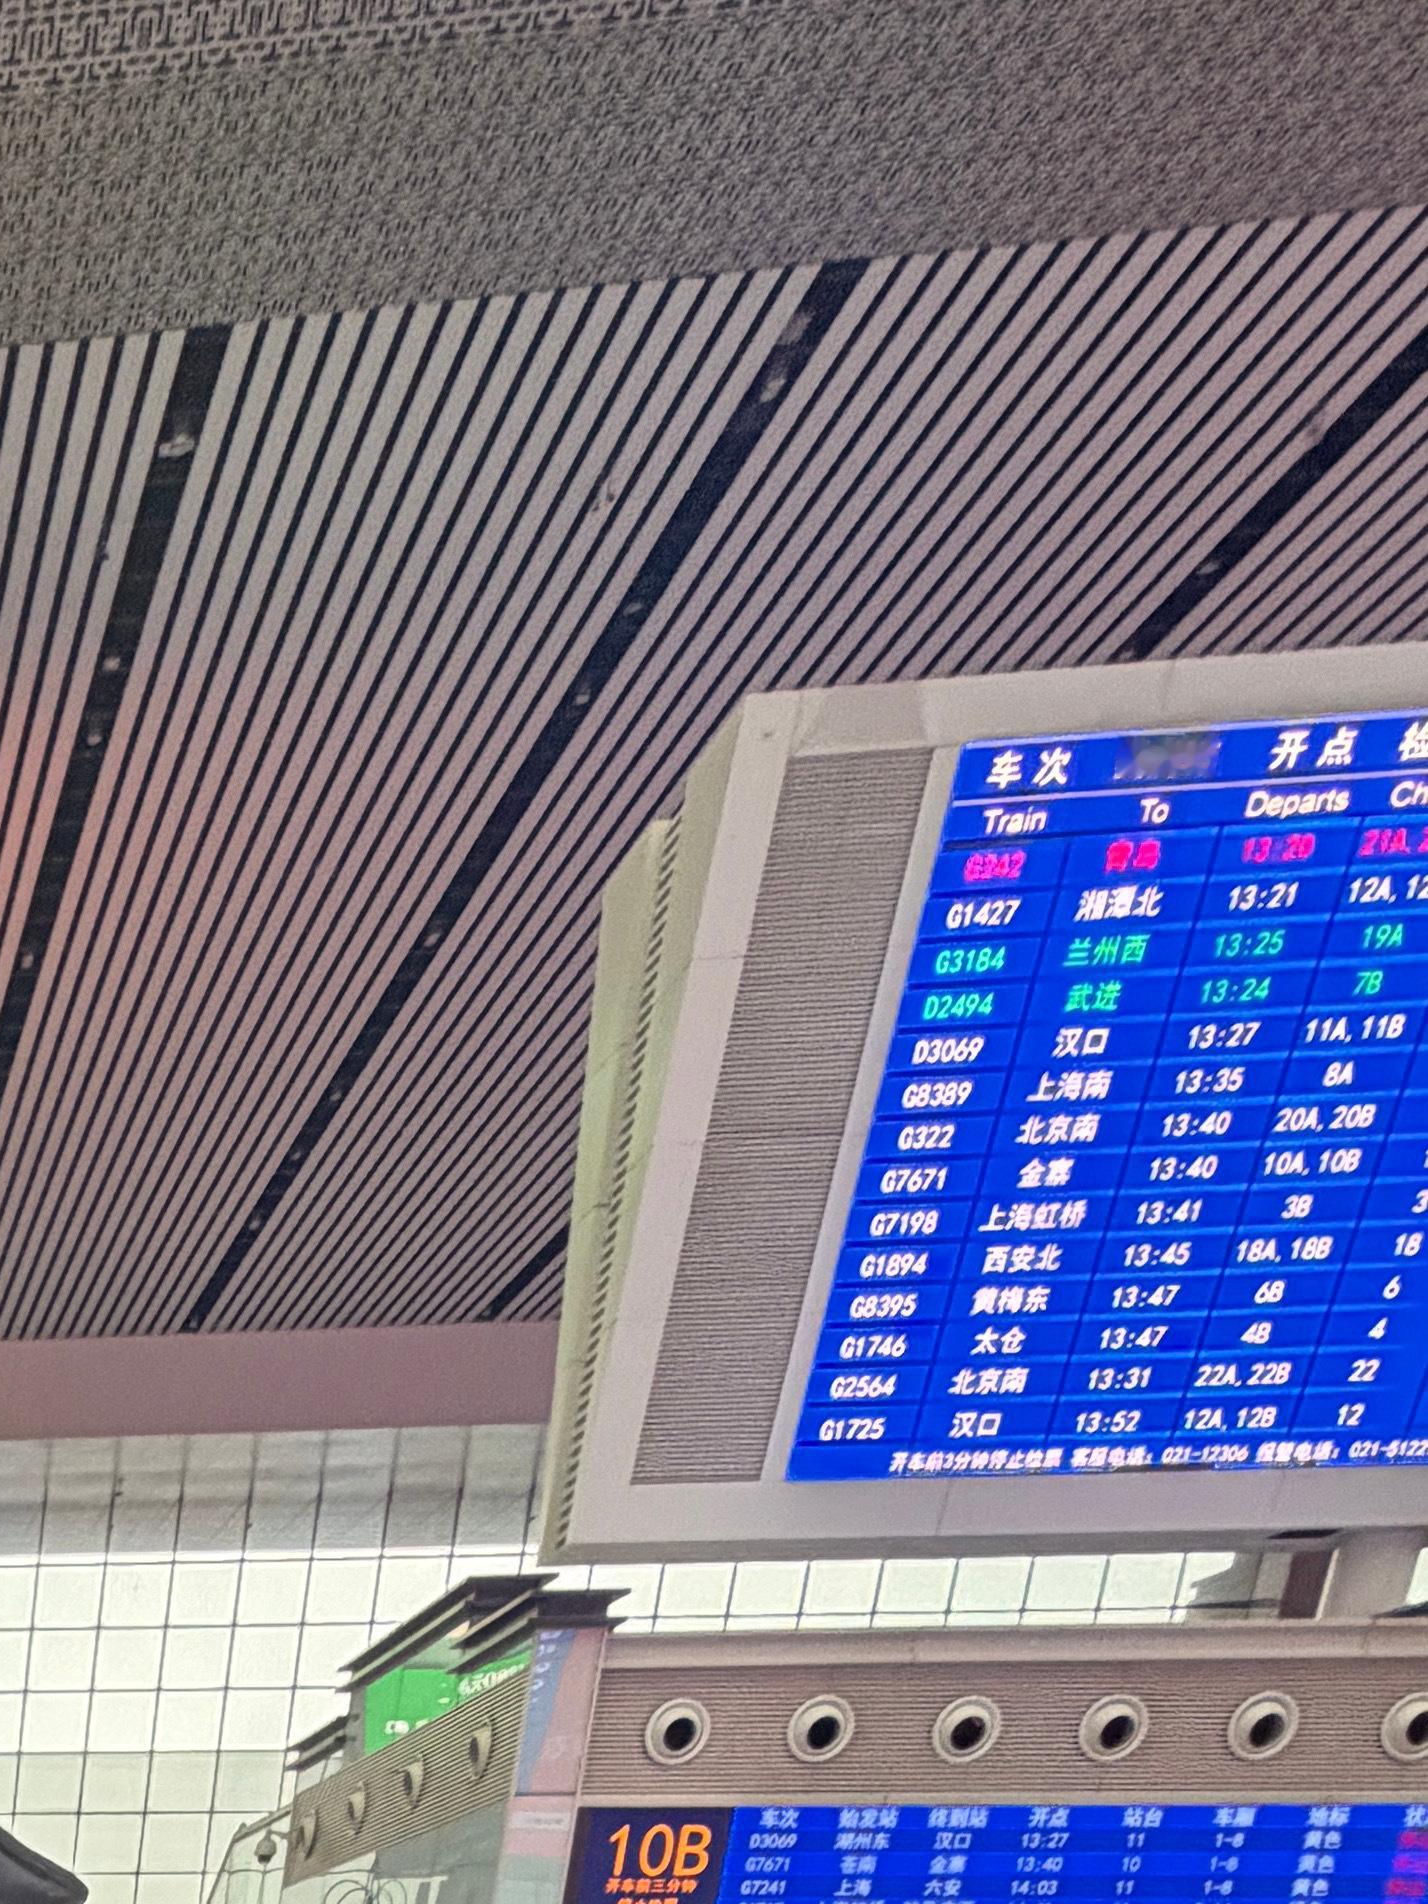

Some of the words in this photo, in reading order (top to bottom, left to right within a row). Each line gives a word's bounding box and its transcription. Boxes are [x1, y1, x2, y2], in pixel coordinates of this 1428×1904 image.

[985, 746, 1072, 790] 车次
[1268, 725, 1359, 771] 开点
[983, 806, 1048, 836] Train
[1140, 796, 1170, 825] To
[1243, 787, 1350, 820] Departs
[946, 899, 1021, 929] G1427
[1074, 884, 1164, 921] 湘潭北
[1229, 882, 1299, 911] 13:21
[935, 946, 1006, 975] G3184
[1063, 934, 1150, 967] 兰州西
[1216, 929, 1285, 957] 13:25
[1363, 923, 1403, 949] 19A
[922, 992, 994, 1020] D2494
[1064, 980, 1122, 1012] 武进
[1202, 977, 1271, 1004] 13:24
[1354, 970, 1384, 995] 7B
[911, 1036, 985, 1065] D3069
[1052, 1027, 1110, 1058] 汉口
[1189, 1021, 1261, 1049] 13:27
[1362, 1013, 1406, 1039] 11B
[901, 1080, 973, 1109] G8389
[1026, 1069, 1113, 1102] 上海南
[1175, 1066, 1245, 1094] 13:35
[1322, 1061, 1354, 1087] 8A
[897, 1123, 956, 1151] G322
[1015, 1112, 1101, 1145] 北京南
[1162, 1110, 1232, 1137] 13:40
[1328, 1103, 1377, 1130] 20B
[880, 1167, 948, 1194] G7671
[1017, 1156, 1075, 1188] 金寨
[1150, 1155, 1219, 1181] 13:40
[1318, 1148, 1363, 1174] 10B
[869, 1209, 939, 1237] G7198
[978, 1199, 1087, 1232] 上海虹桥
[1137, 1199, 1202, 1225] 13:41
[1281, 1194, 1314, 1219] 3B
[859, 1252, 929, 1279] G1894
[981, 1243, 1063, 1274] 西安北
[1124, 1242, 1192, 1267] 13:45
[1291, 1235, 1334, 1261] 18B
[1395, 1232, 1423, 1257] 18
[849, 1293, 918, 1319] G8395
[970, 1285, 1051, 1316] 黄梅东
[1112, 1284, 1181, 1309] 13:47
[1254, 1280, 1286, 1304] 6B
[1382, 1275, 1401, 1300] 6
[839, 1334, 907, 1360] G1746
[970, 1326, 1027, 1355] 太仓
[1100, 1325, 1169, 1350] 13:47
[1240, 1321, 1272, 1345] 4B
[1368, 1317, 1388, 1339] 4
[829, 1374, 897, 1400] G2564
[947, 1366, 1030, 1395] 北京南
[1088, 1367, 1152, 1391] 13:31
[1246, 1361, 1292, 1386] 22B
[1347, 1358, 1381, 1382] 22
[819, 1417, 886, 1442] G1725
[949, 1411, 1002, 1439] 汉口
[1076, 1410, 1141, 1434] 13:52
[1237, 1406, 1277, 1429] 12B
[1337, 1403, 1365, 1426] 12
[749, 1832, 798, 1849] D3069
[934, 1831, 972, 1850] 汉口
[1022, 1832, 1070, 1849] 13:27
[1127, 1832, 1145, 1847] 11
[1216, 1832, 1245, 1848] 1-8
[1304, 1830, 1341, 1849] 黄色
[759, 1808, 799, 1830] 车次
[838, 1807, 900, 1830] 始发站
[927, 1807, 990, 1830] 终到站
[1028, 1808, 1069, 1828] 开点
[1121, 1808, 1163, 1828] 站台
[608, 1823, 713, 1878] 10B
[745, 1856, 790, 1872] G7671
[1017, 1856, 1063, 1872] 13:40
[1122, 1855, 1141, 1873] 10
[1297, 1854, 1334, 1874] 黄色
[604, 1877, 699, 1896] 开车前三分钟
[740, 1879, 786, 1895] G7241
[834, 1879, 872, 1897] 上海
[924, 1878, 961, 1897] 六安
[1011, 1879, 1058, 1896] 14:03
[1116, 1879, 1135, 1895] 11
[1204, 1880, 1233, 1896] 1-8
[1292, 1878, 1329, 1897] 黄色
